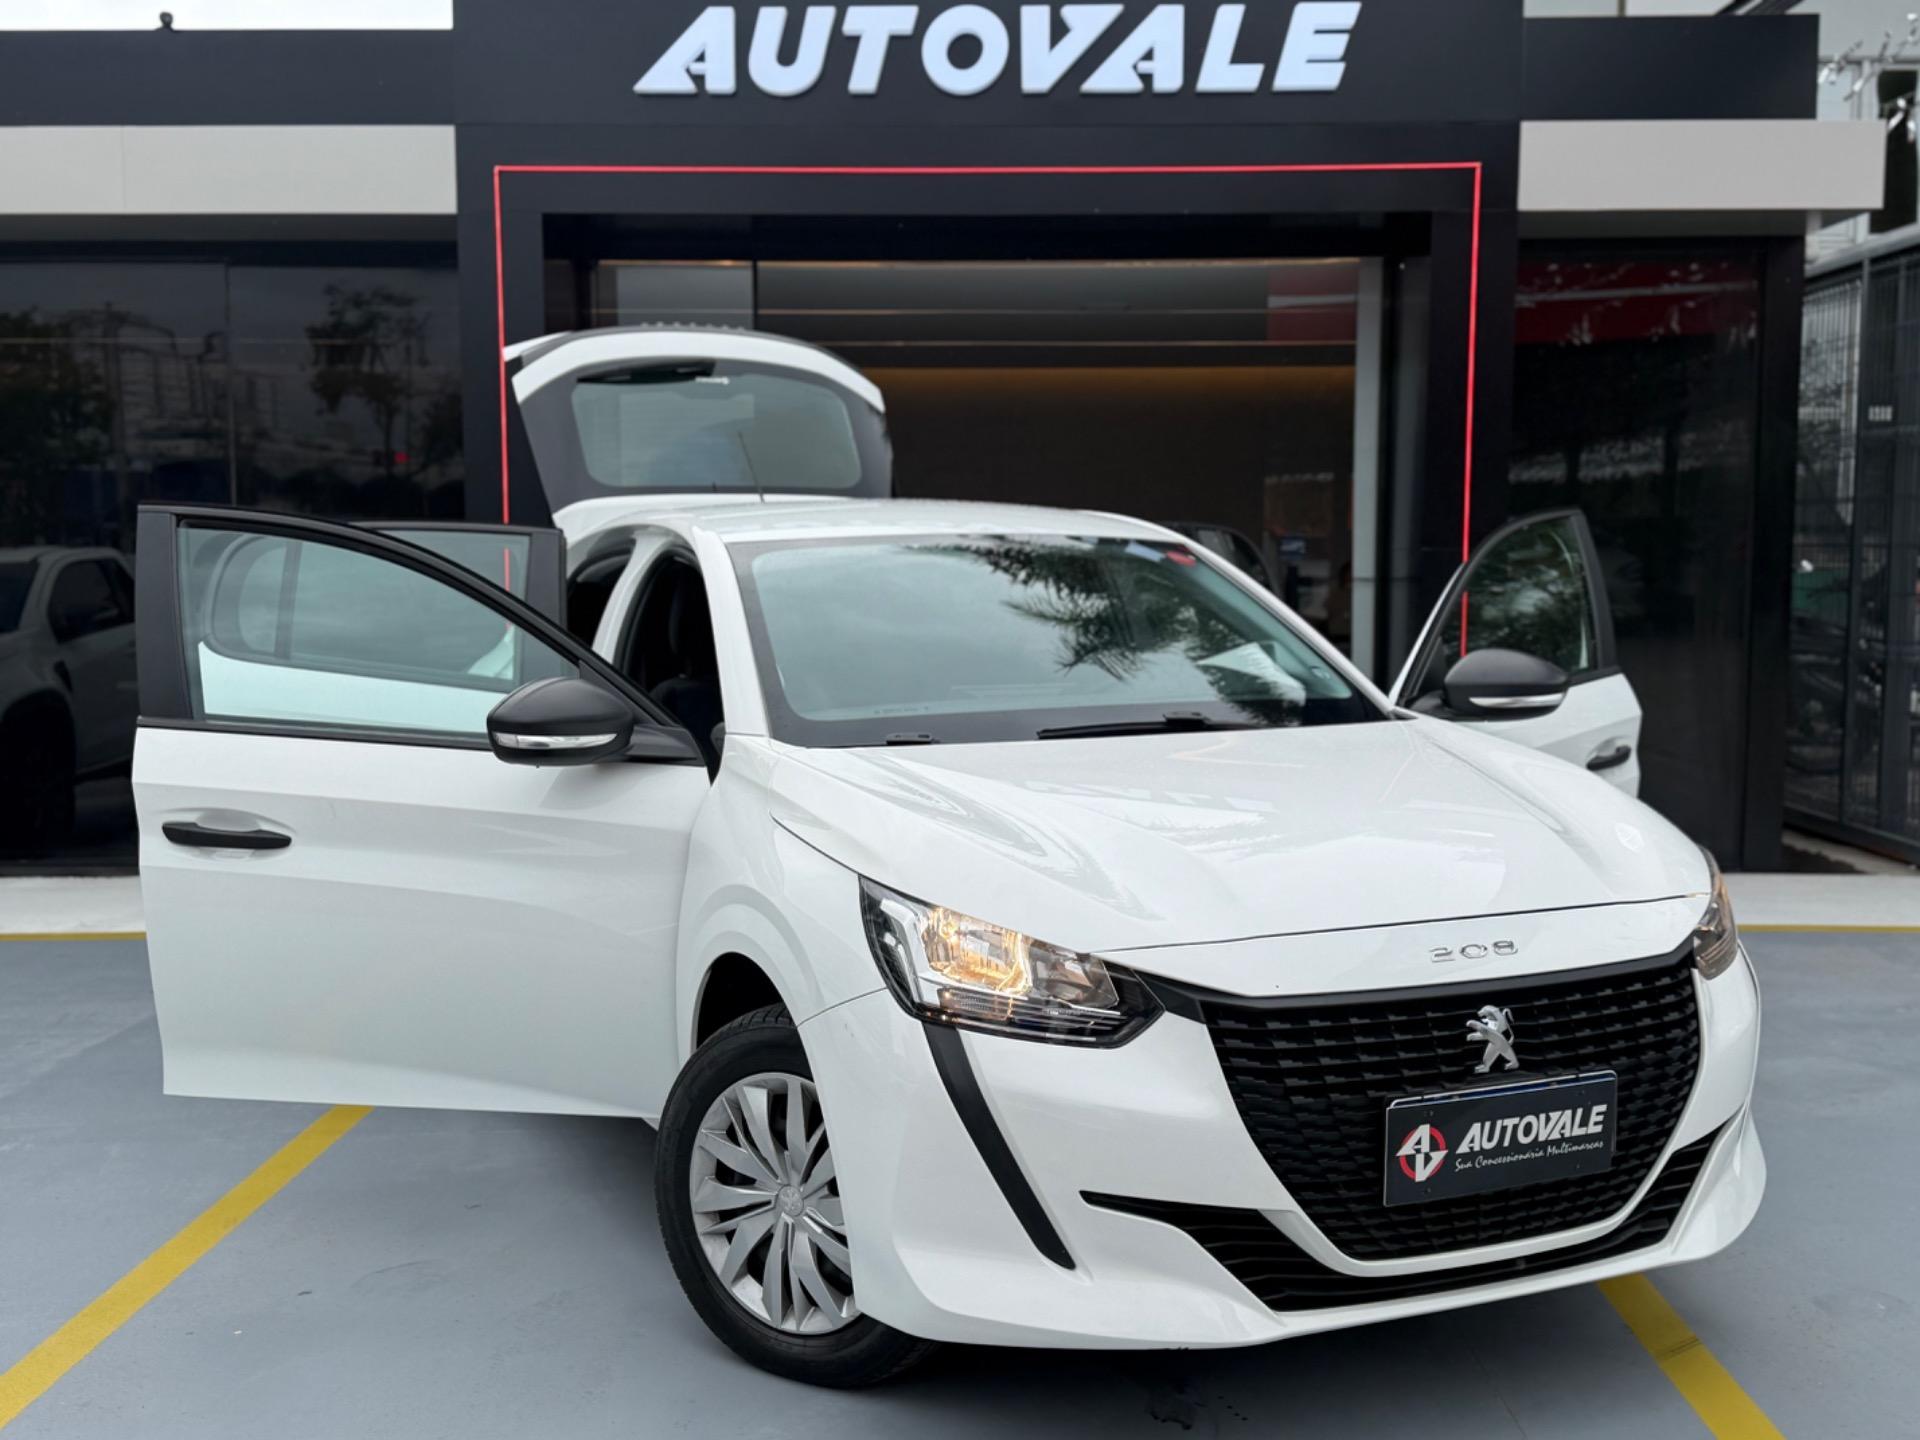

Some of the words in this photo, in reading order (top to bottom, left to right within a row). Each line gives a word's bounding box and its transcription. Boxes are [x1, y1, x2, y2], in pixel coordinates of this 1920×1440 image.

[633, 1, 1361, 95] AUTOVALE
[1429, 940, 1518, 962] 208
[1456, 1104, 1607, 1153] AUTOVALE
